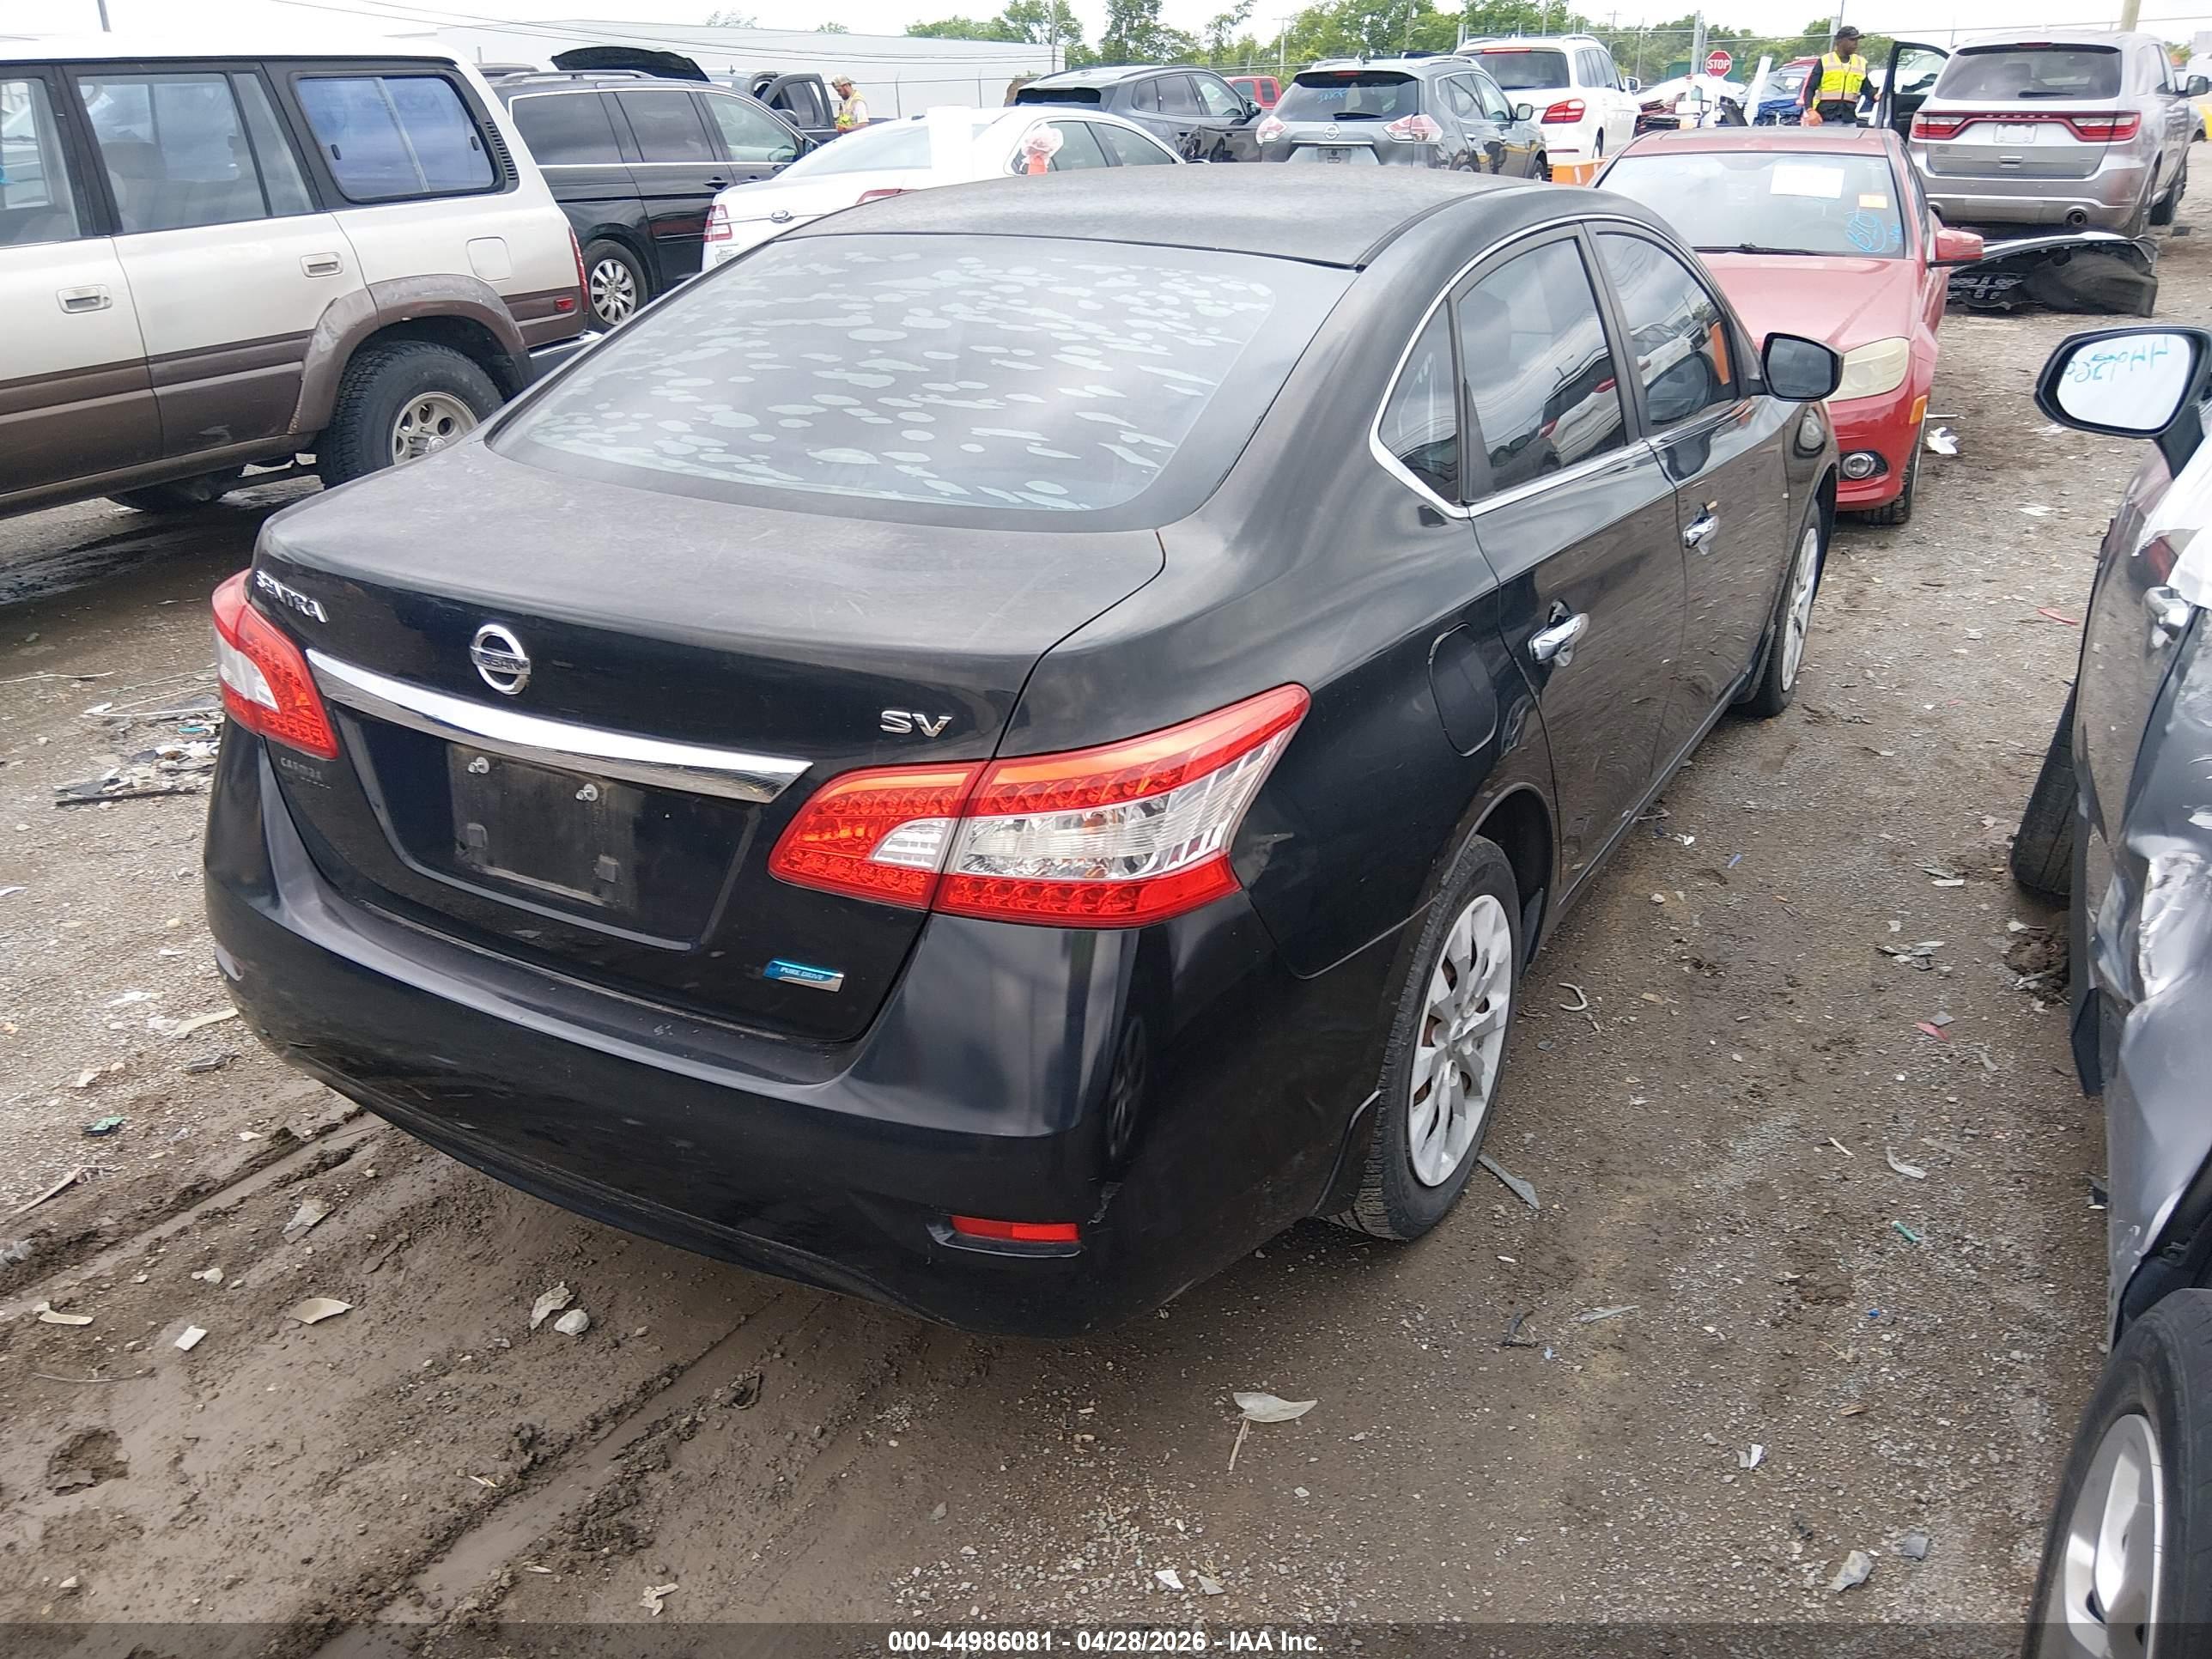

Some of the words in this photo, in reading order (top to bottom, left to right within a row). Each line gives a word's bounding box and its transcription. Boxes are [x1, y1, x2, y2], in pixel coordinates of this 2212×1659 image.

[1707, 59, 1730, 70] STOP
[256, 569, 330, 623] SENTRA
[879, 710, 953, 738] SV
